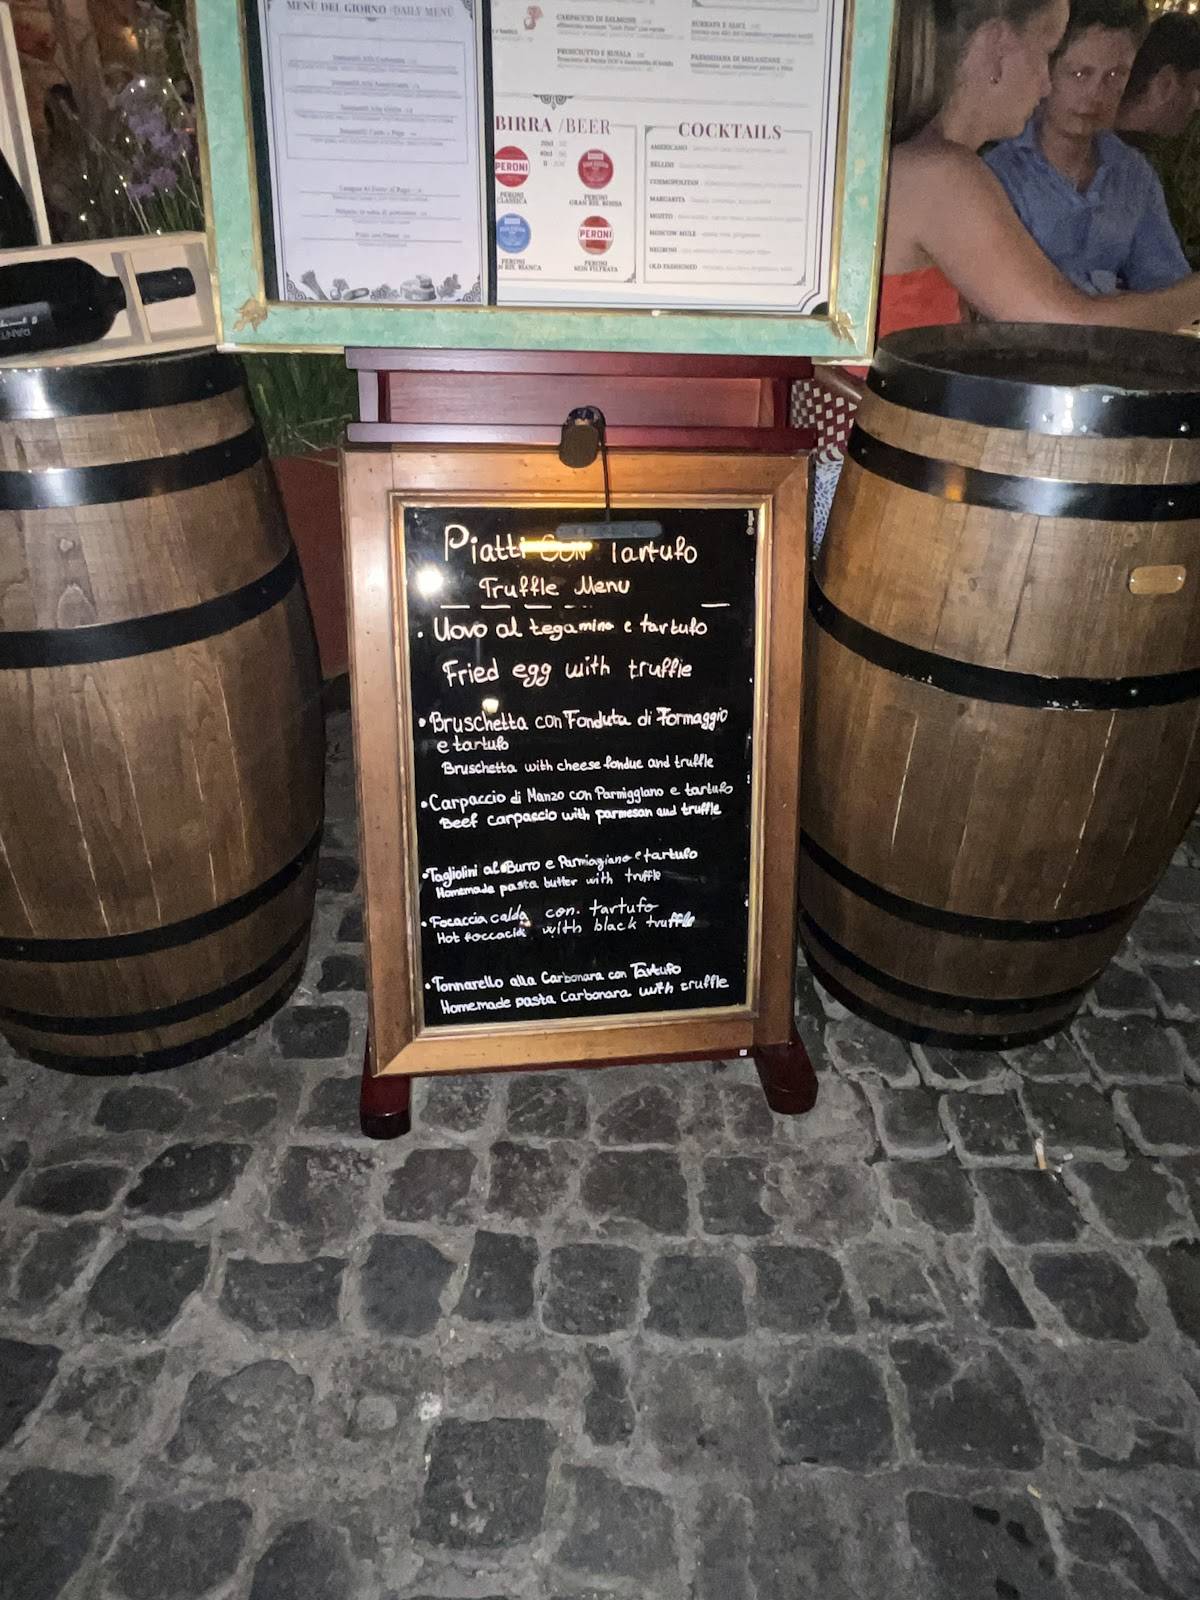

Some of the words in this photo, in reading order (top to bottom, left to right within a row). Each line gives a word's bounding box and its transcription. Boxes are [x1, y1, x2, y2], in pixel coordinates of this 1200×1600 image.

[344, 3, 387, 14] GIORNO
[495, 115, 552, 132] BIRRA
[678, 121, 782, 140] COCKTAILS
[650, 143, 688, 151] AMERICANO
[494, 161, 528, 172] PERONI
[649, 195, 686, 203] MARGARITA
[579, 229, 612, 239] PERONI
[444, 524, 527, 564] Piatti
[478, 575, 560, 598] Truffle
[574, 575, 631, 595] Menu
[433, 616, 488, 642] Uovo
[496, 615, 523, 639] al
[528, 617, 615, 642] tegamino
[623, 620, 633, 633] e
[639, 612, 708, 636] tartufo
[442, 657, 500, 688] Fried
[512, 662, 552, 688] egg
[565, 653, 611, 679] with
[429, 710, 529, 734] Bruschetta
[534, 714, 563, 730] con
[562, 707, 632, 730] Fonduta
[637, 707, 653, 727] di
[655, 706, 729, 732] Formaggio
[436, 739, 450, 754] e
[452, 734, 510, 753] tartufo
[440, 759, 518, 776] Bruschetta
[524, 758, 554, 773] with
[556, 758, 601, 773] cheese
[602, 754, 644, 771] fondue
[647, 754, 671, 769] and
[673, 752, 715, 770] truffle
[429, 789, 507, 814] Carpaccio
[510, 789, 522, 805] di
[526, 787, 565, 804] Manzo
[568, 788, 593, 801] con
[669, 786, 681, 797] e
[684, 780, 734, 797] tartufo
[438, 812, 479, 830] Beef
[486, 808, 558, 829] carpaccio
[561, 806, 591, 822] with
[594, 808, 654, 825] parmesan
[680, 801, 722, 817] truffle
[426, 863, 478, 888] Tagliolini
[483, 860, 501, 876] al
[501, 859, 541, 875] Burro
[544, 859, 556, 870] e
[634, 850, 642, 860] e
[643, 846, 699, 864] tartufo
[435, 883, 496, 899] Homemade
[499, 879, 540, 898] pasta
[543, 875, 579, 890] butter
[585, 871, 614, 885] with
[624, 866, 662, 884] truffle
[429, 911, 489, 929] Focaccia
[489, 903, 530, 923] calda
[588, 895, 660, 917] tartufo
[436, 931, 461, 945] Hot
[541, 918, 583, 936] with
[593, 915, 638, 933] black
[645, 910, 696, 929] truffle
[431, 974, 504, 993] Tonnarello
[509, 973, 537, 988] alla
[540, 969, 605, 985] Carbonara
[607, 969, 628, 981] con
[629, 961, 682, 980] Tartufo
[440, 997, 512, 1015] Homemade
[515, 992, 557, 1009] pasta
[560, 988, 633, 1003] Carbonara
[638, 980, 674, 998] with
[679, 973, 730, 992] truffle
